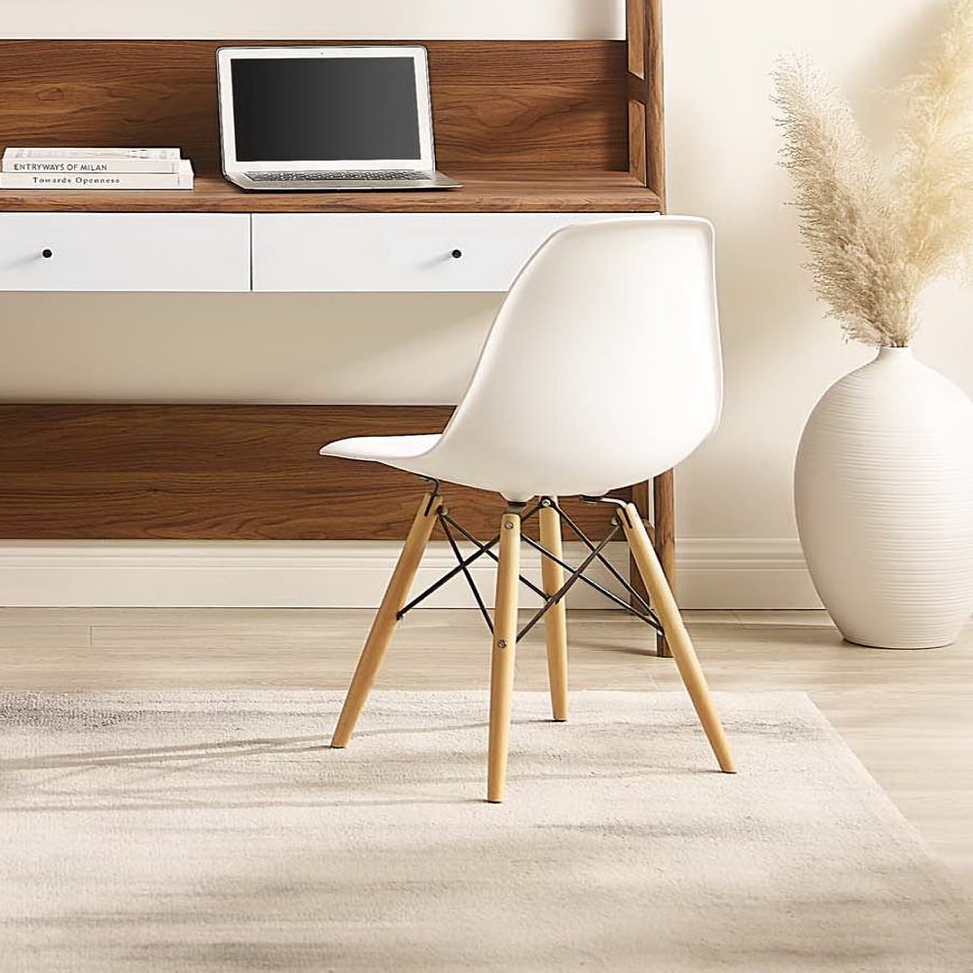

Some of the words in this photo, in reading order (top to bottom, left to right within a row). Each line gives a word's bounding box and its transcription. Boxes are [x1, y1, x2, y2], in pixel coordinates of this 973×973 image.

[13, 163, 65, 171] ENTRYWAYS
[66, 163, 79, 171] OF
[79, 163, 108, 172] MILAN
[32, 176, 72, 184] Towards
[74, 176, 121, 185] Openness
